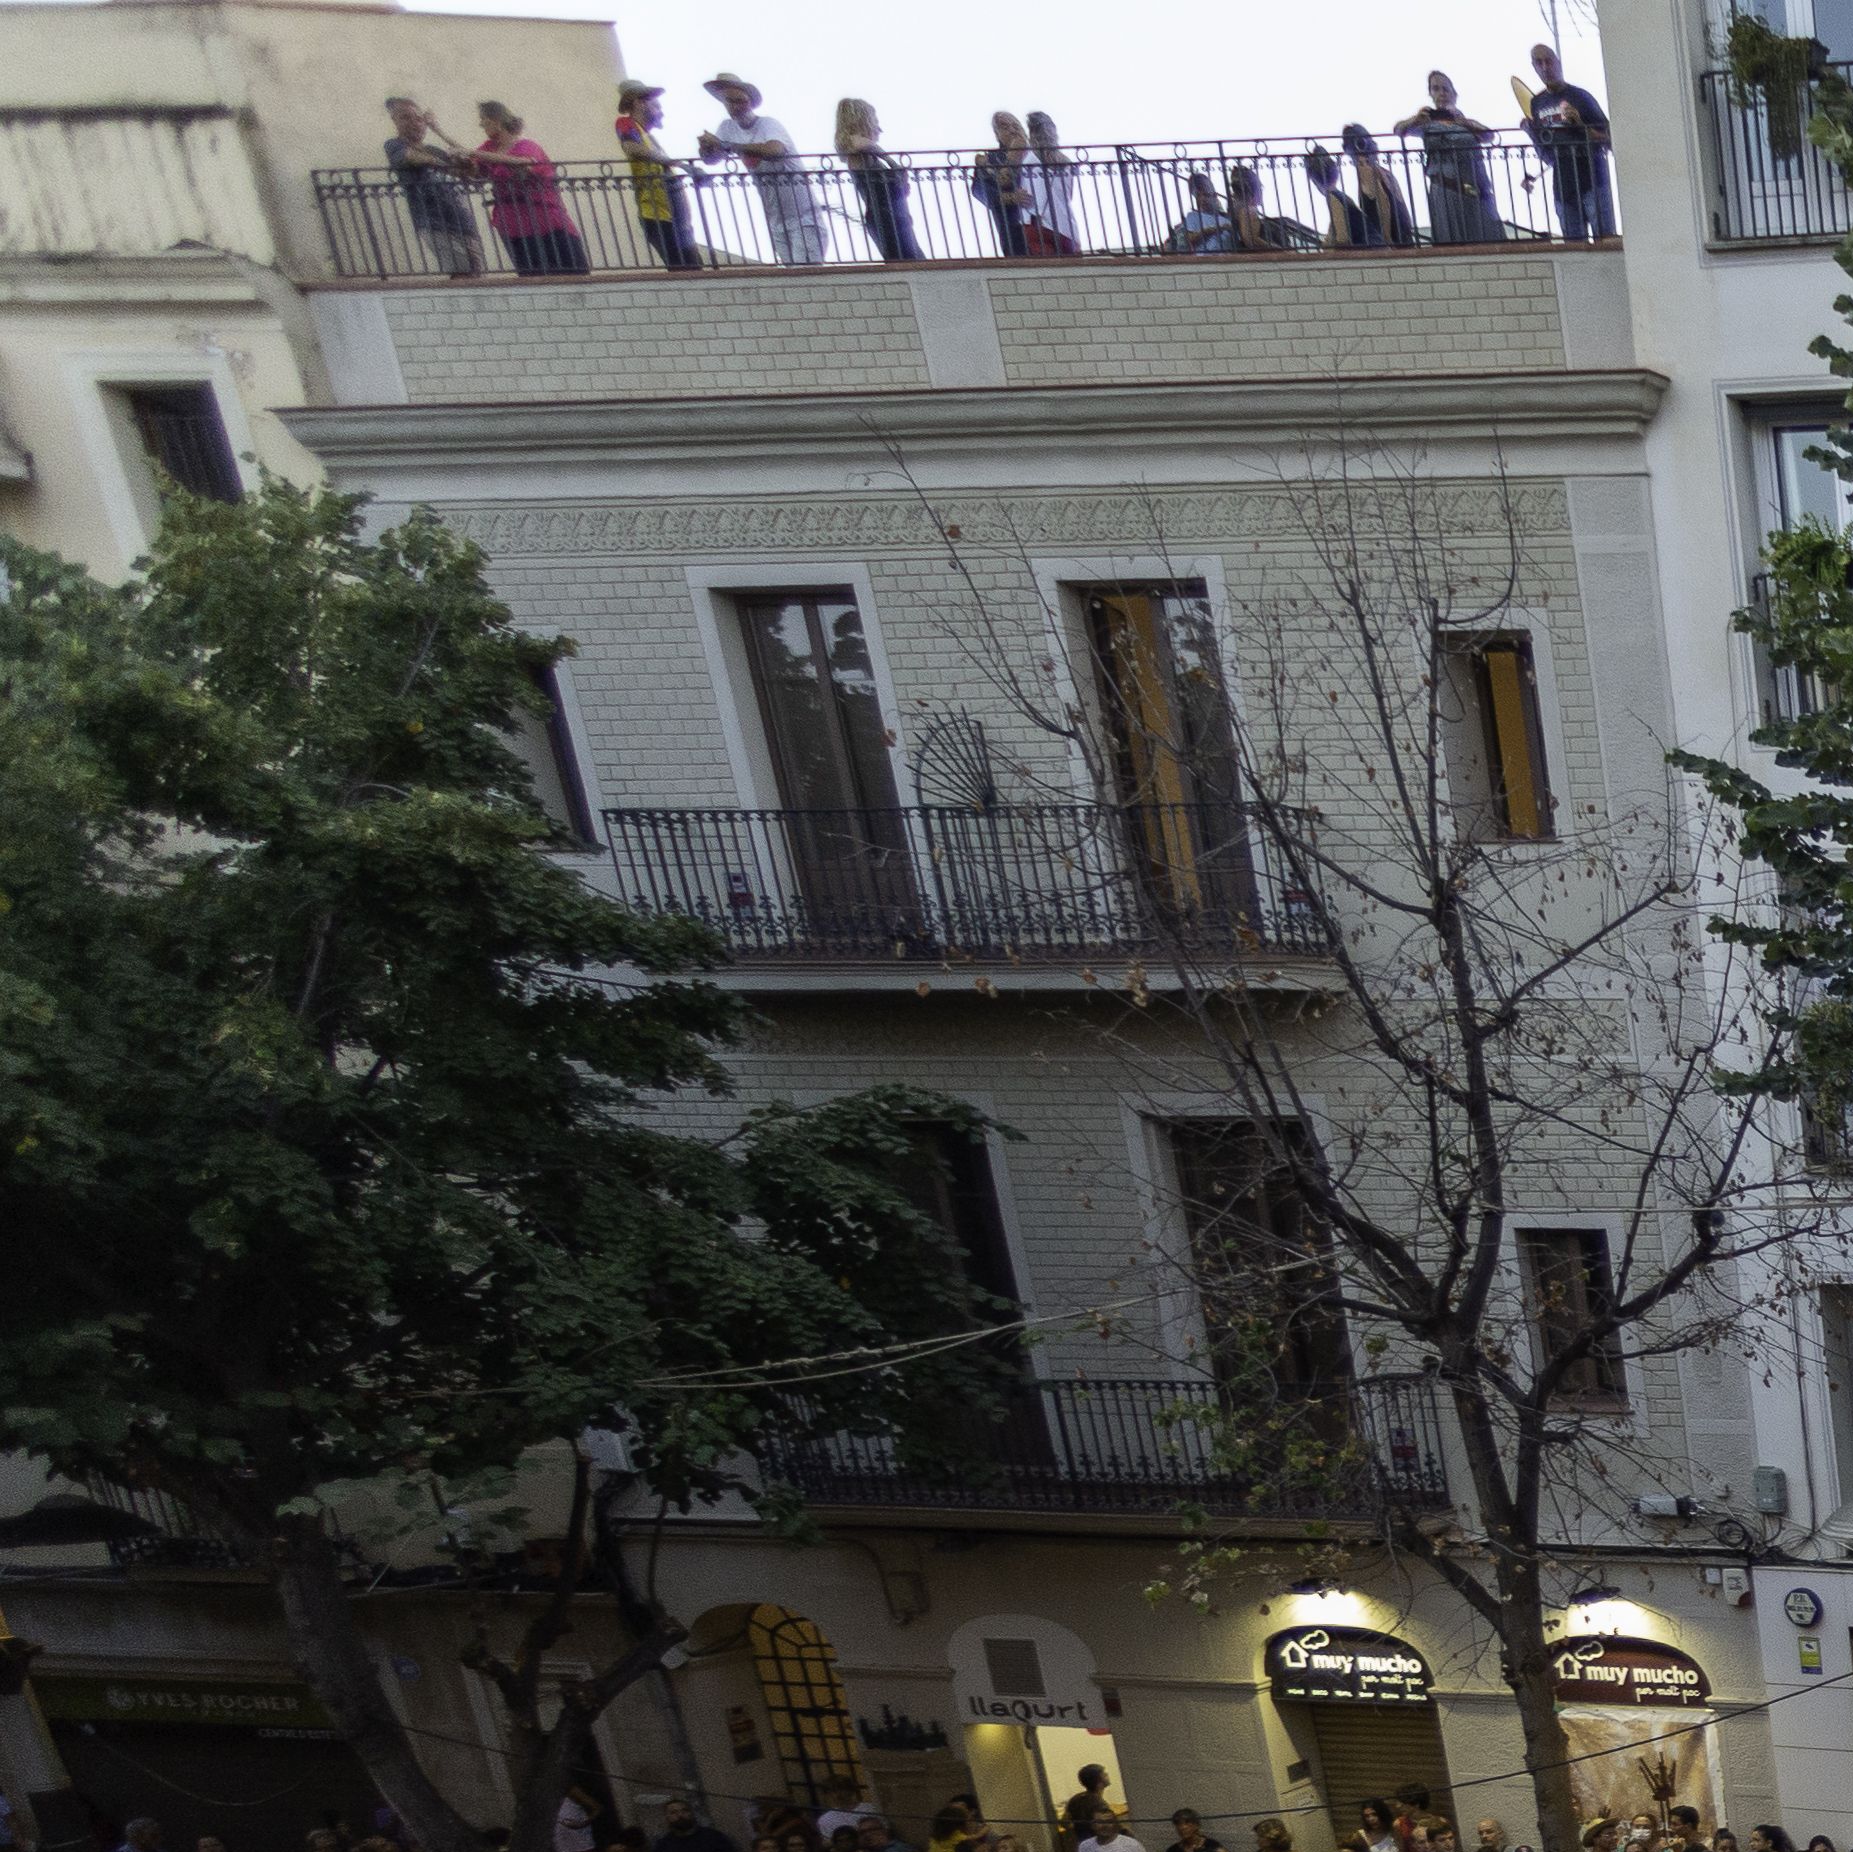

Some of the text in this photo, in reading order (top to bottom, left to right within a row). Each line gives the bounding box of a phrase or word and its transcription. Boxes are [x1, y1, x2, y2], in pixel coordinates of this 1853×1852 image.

[1311, 1654, 1422, 1674] muy mucho
[1585, 1665, 1698, 1686] muy mucho
